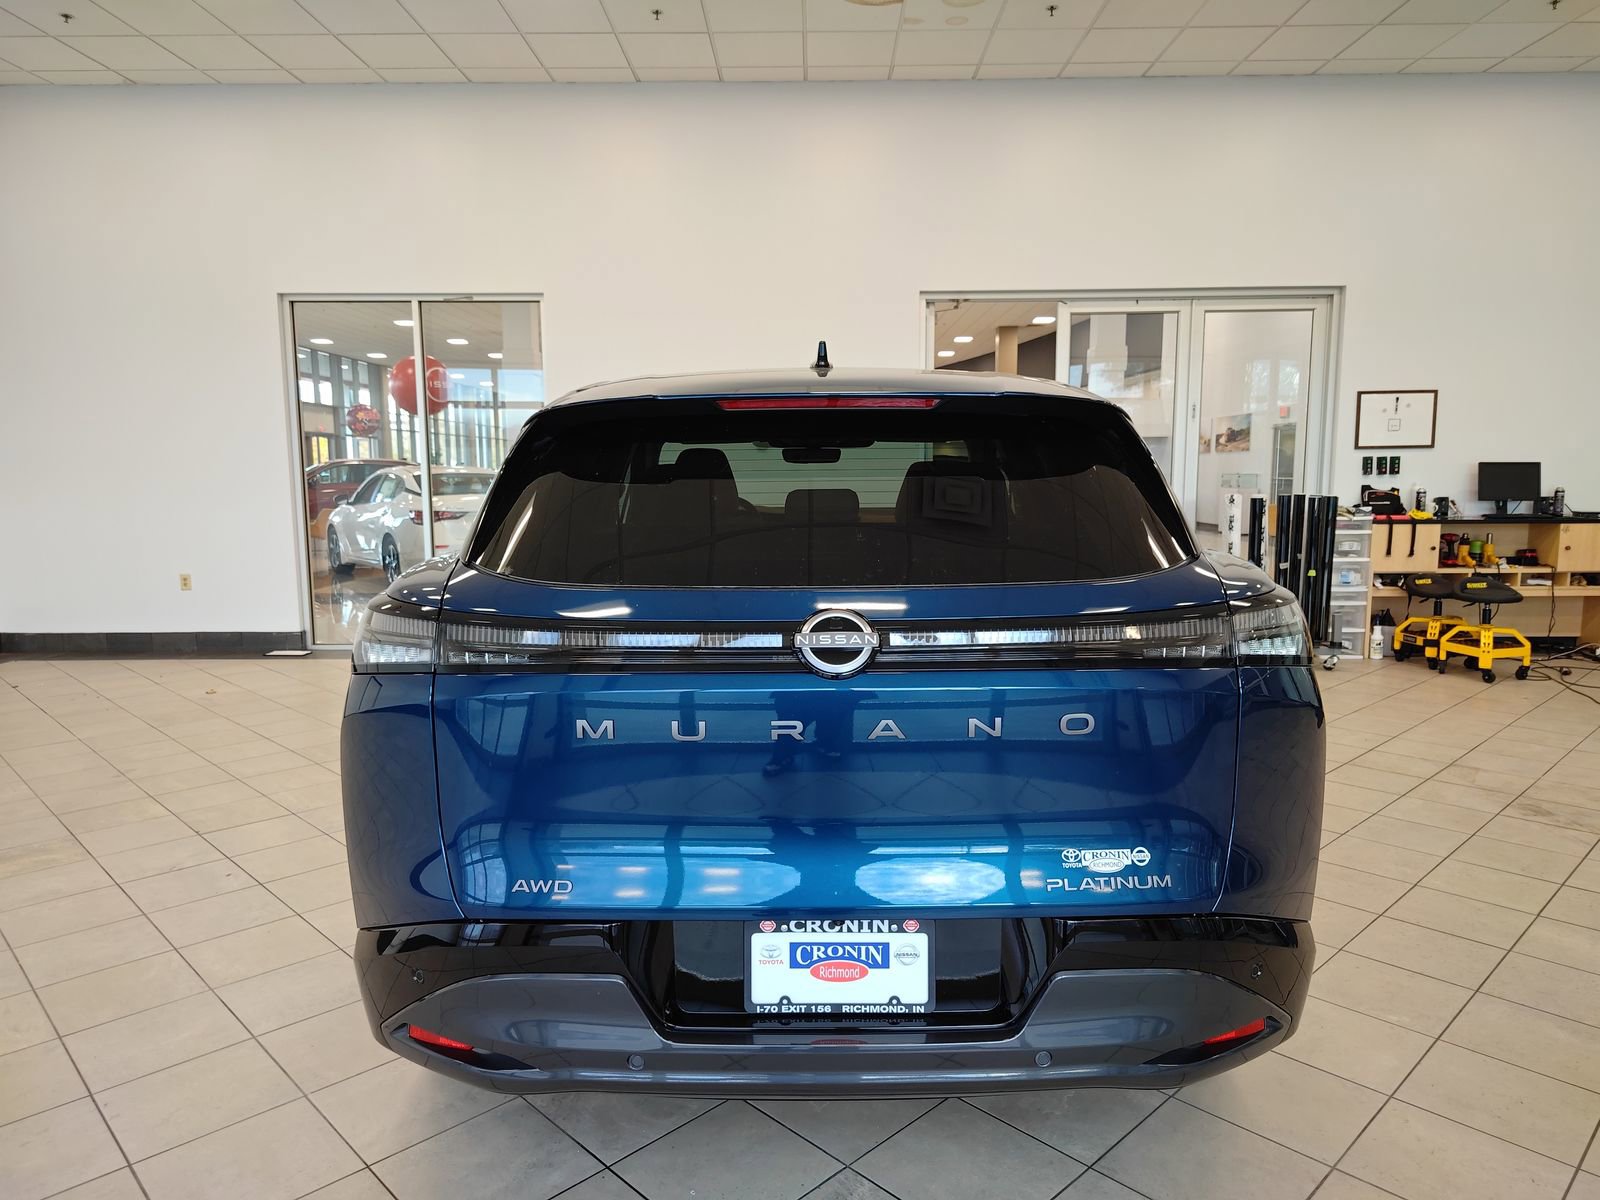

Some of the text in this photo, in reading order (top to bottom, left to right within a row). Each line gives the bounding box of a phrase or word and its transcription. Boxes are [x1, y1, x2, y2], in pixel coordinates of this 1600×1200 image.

[796, 634, 877, 645] NISSAN
[575, 712, 1096, 742] MURANO
[1083, 850, 1130, 861] CRONIN
[511, 879, 574, 893] AWD
[1046, 875, 1172, 892] PLATINUM
[789, 919, 889, 933] CRONIN
[796, 944, 883, 966] CRONIN
[819, 966, 860, 979] Richmond
[756, 1005, 925, 1013] I-70 EXIT 156 RICHMOND, IN
